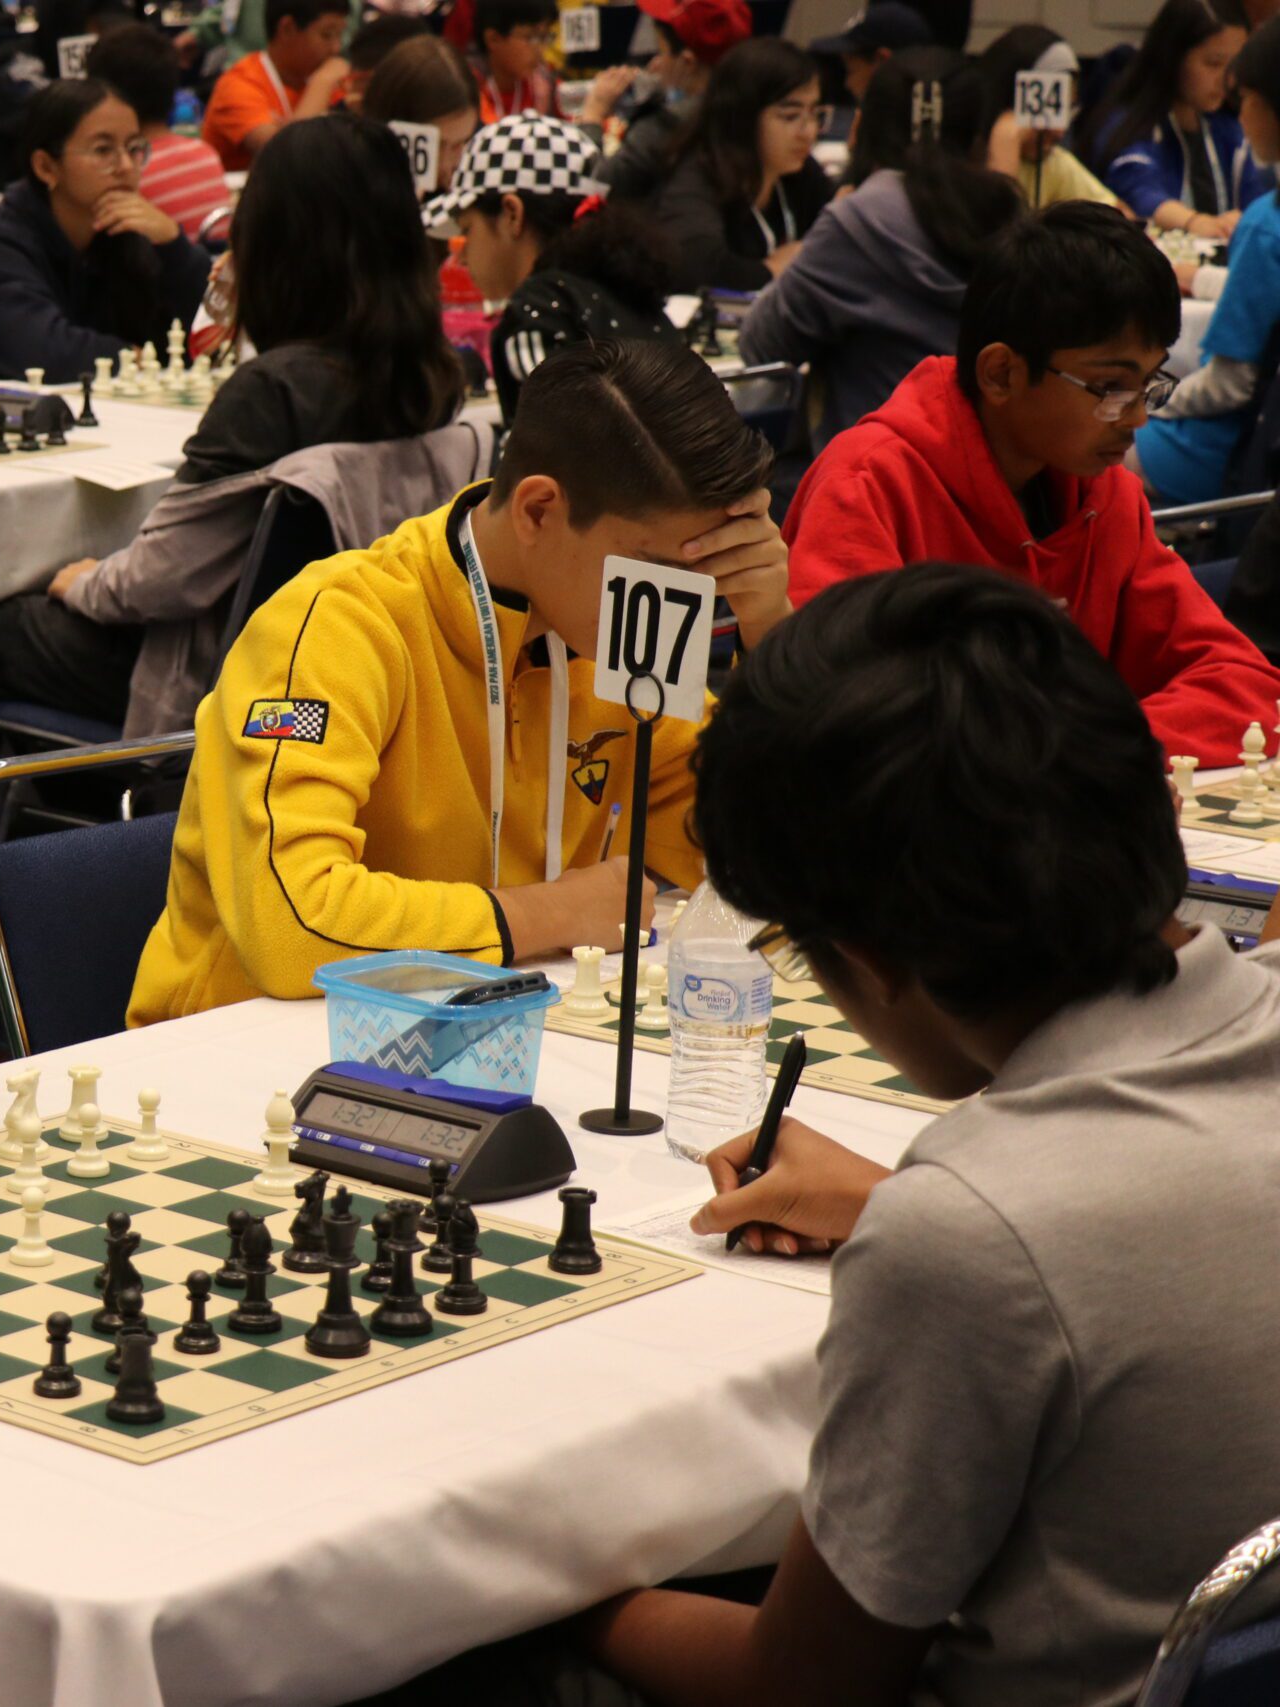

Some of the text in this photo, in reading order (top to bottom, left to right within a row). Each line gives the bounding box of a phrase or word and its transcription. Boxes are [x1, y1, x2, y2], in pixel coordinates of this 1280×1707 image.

[1020, 80, 1062, 116] 134
[477, 594, 492, 622] YOUTH
[607, 576, 702, 686] 107
[484, 623, 499, 684] PAN-AMERICAN
[697, 993, 731, 1004] Drinking
[707, 1002, 730, 1011] Water
[78, 1425, 98, 1434] 8
